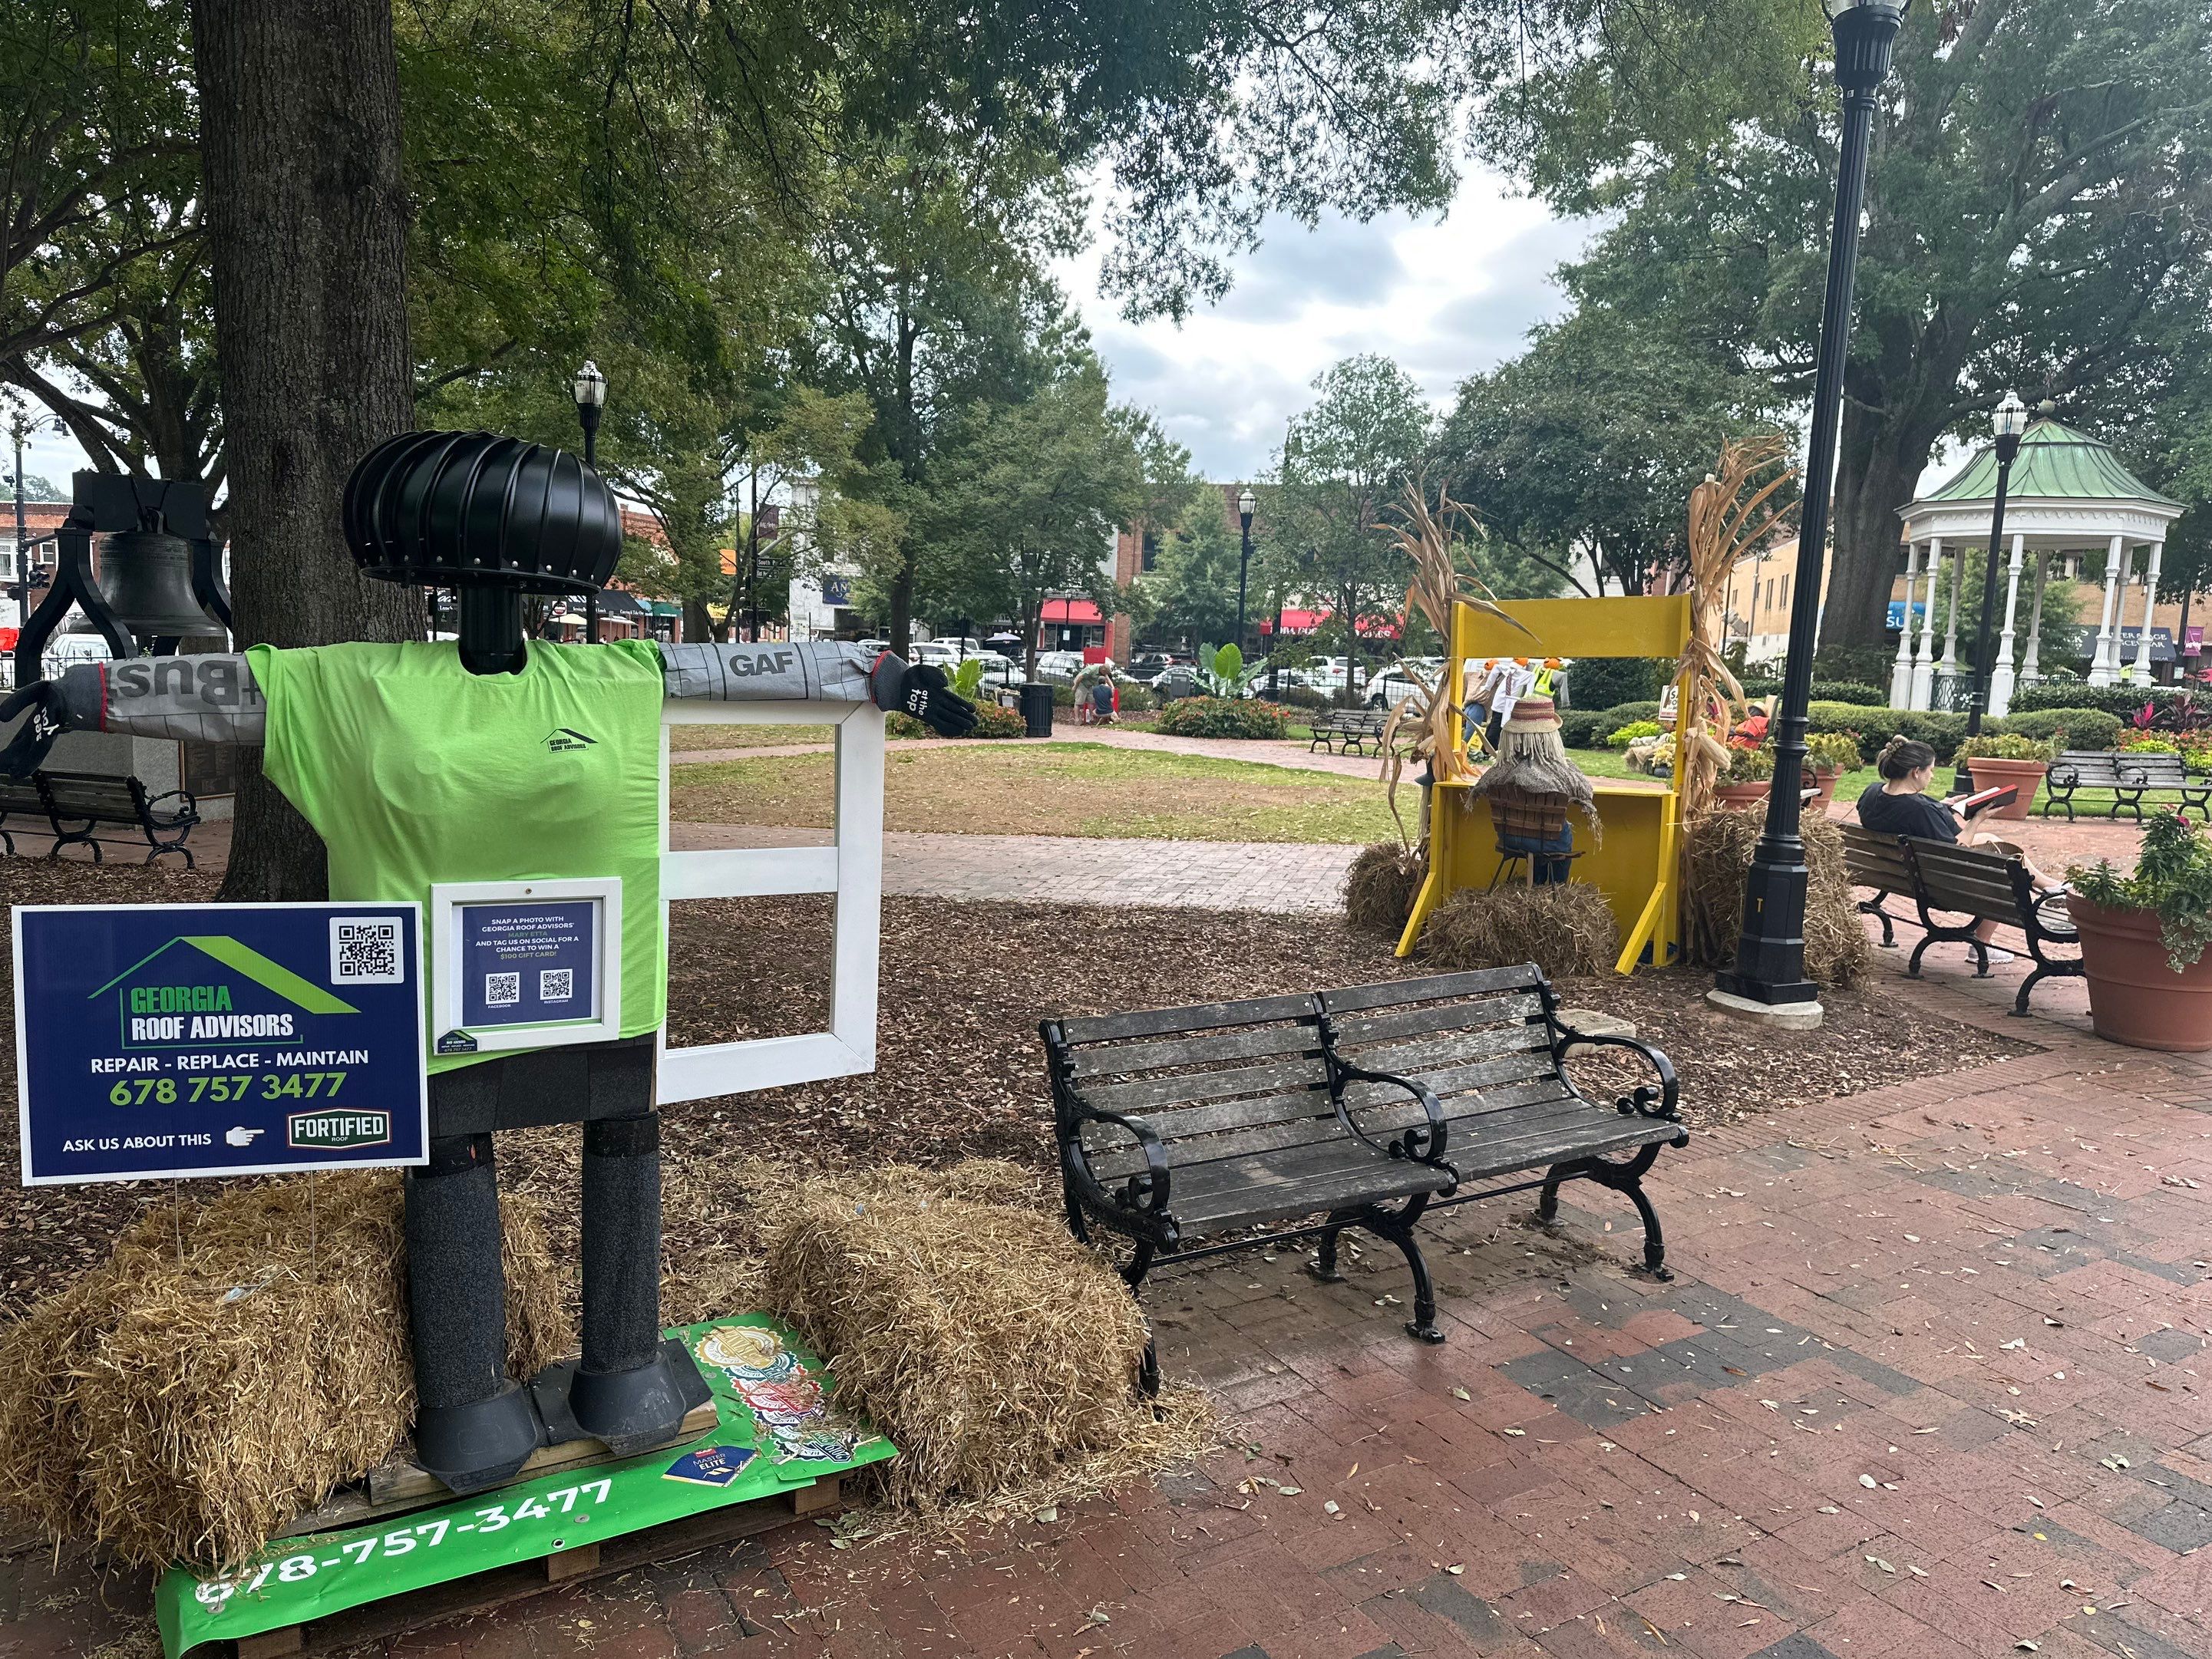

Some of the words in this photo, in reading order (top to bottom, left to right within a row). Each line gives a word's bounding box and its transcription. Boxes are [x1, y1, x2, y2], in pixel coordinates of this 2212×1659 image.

[729, 651, 793, 677] GAF
[907, 688, 922, 712] top
[922, 690, 928, 700] at
[919, 700, 928, 716] the
[130, 985, 233, 1014] GEORGIA
[132, 1017, 184, 1041] ROOF
[190, 1014, 294, 1039] ADVISORS
[91, 1057, 160, 1074] REPAIR
[177, 1054, 259, 1070] REPLACE
[276, 1050, 368, 1067] MAINTAIN
[110, 1078, 177, 1106] 678
[188, 1075, 253, 1103] 757
[261, 1072, 347, 1100] 3477
[295, 1116, 384, 1138] FORTIFIED
[63, 1140, 95, 1152] ASK
[98, 1138, 120, 1150] US
[123, 1136, 175, 1149] ABOUT
[179, 1133, 212, 1146] THIS
[693, 1453, 725, 1466] MASTER
[699, 1459, 726, 1470] ELITE
[195, 1478, 612, 1604] 678-757-3477
